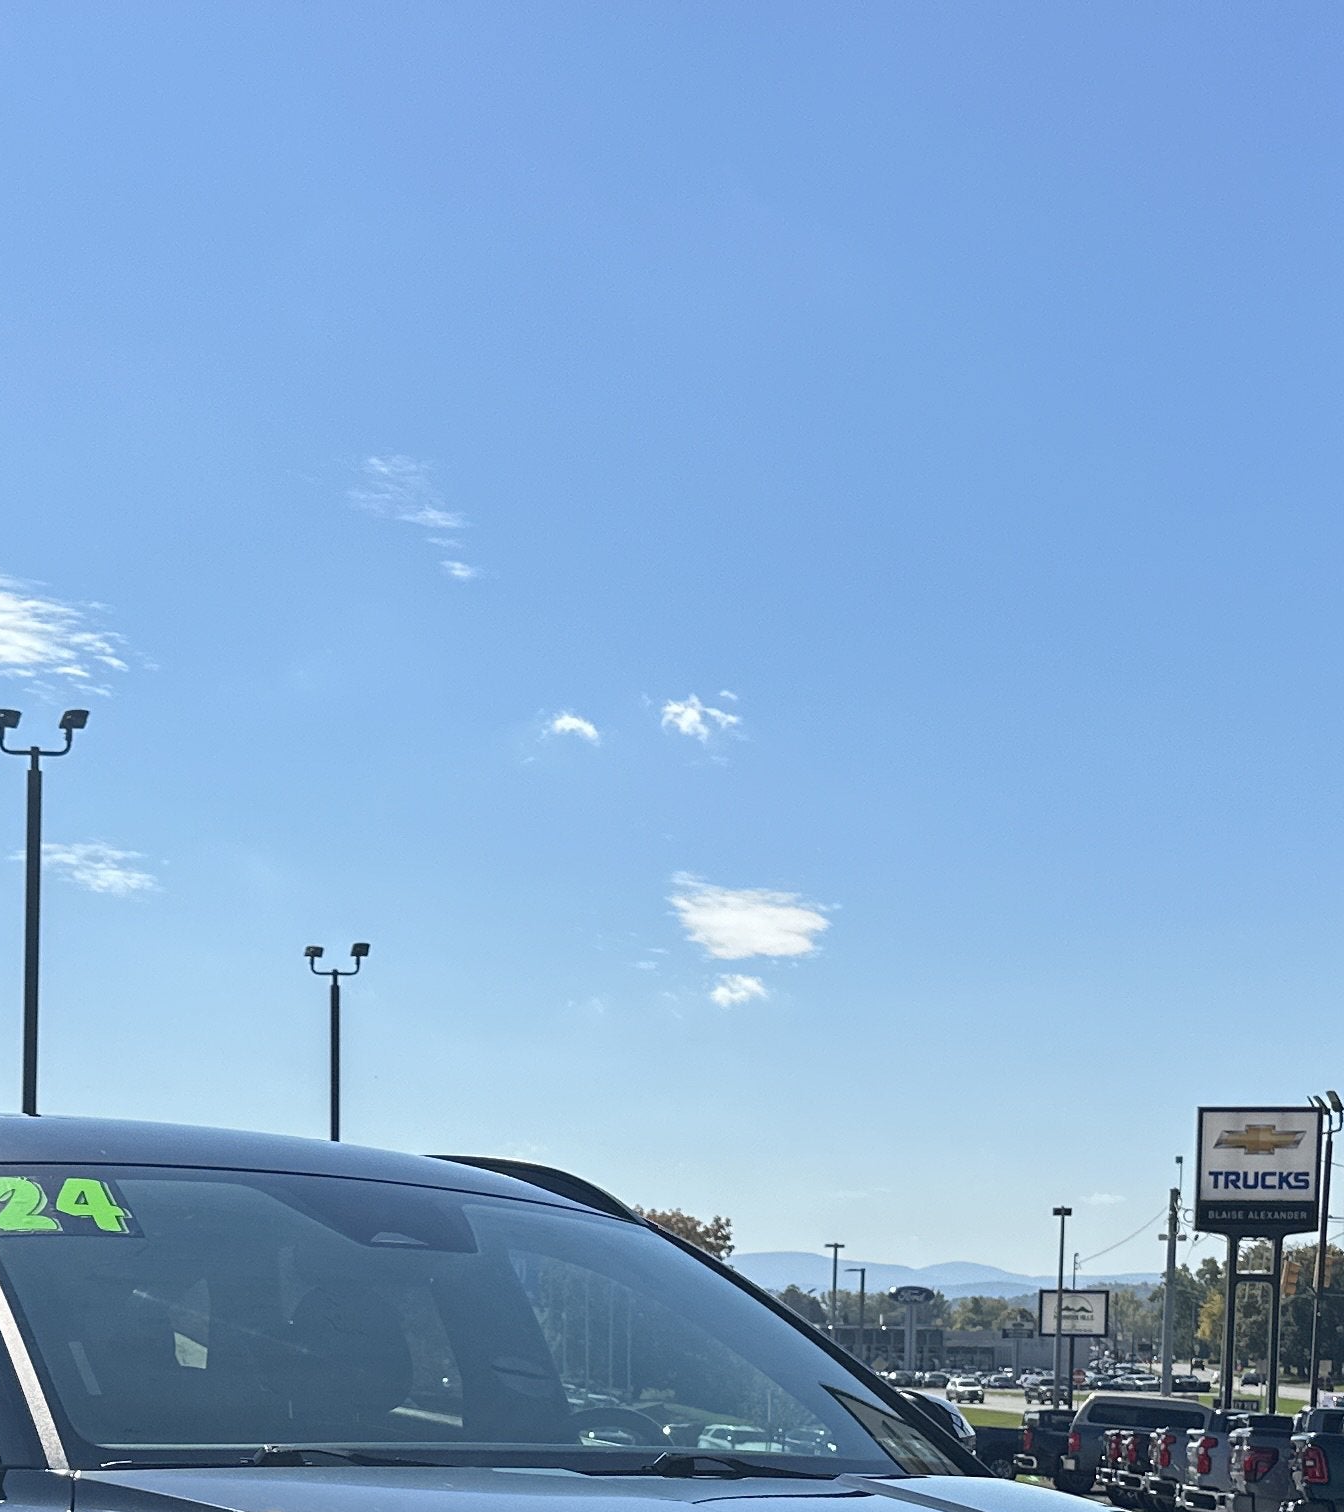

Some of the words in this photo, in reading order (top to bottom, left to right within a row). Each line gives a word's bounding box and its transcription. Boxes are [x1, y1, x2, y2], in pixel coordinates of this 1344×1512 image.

[1208, 1170, 1310, 1190] TRUCKS
[1208, 1210, 1243, 1220] BLAISE
[1247, 1210, 1307, 1220] ALEXANDER
